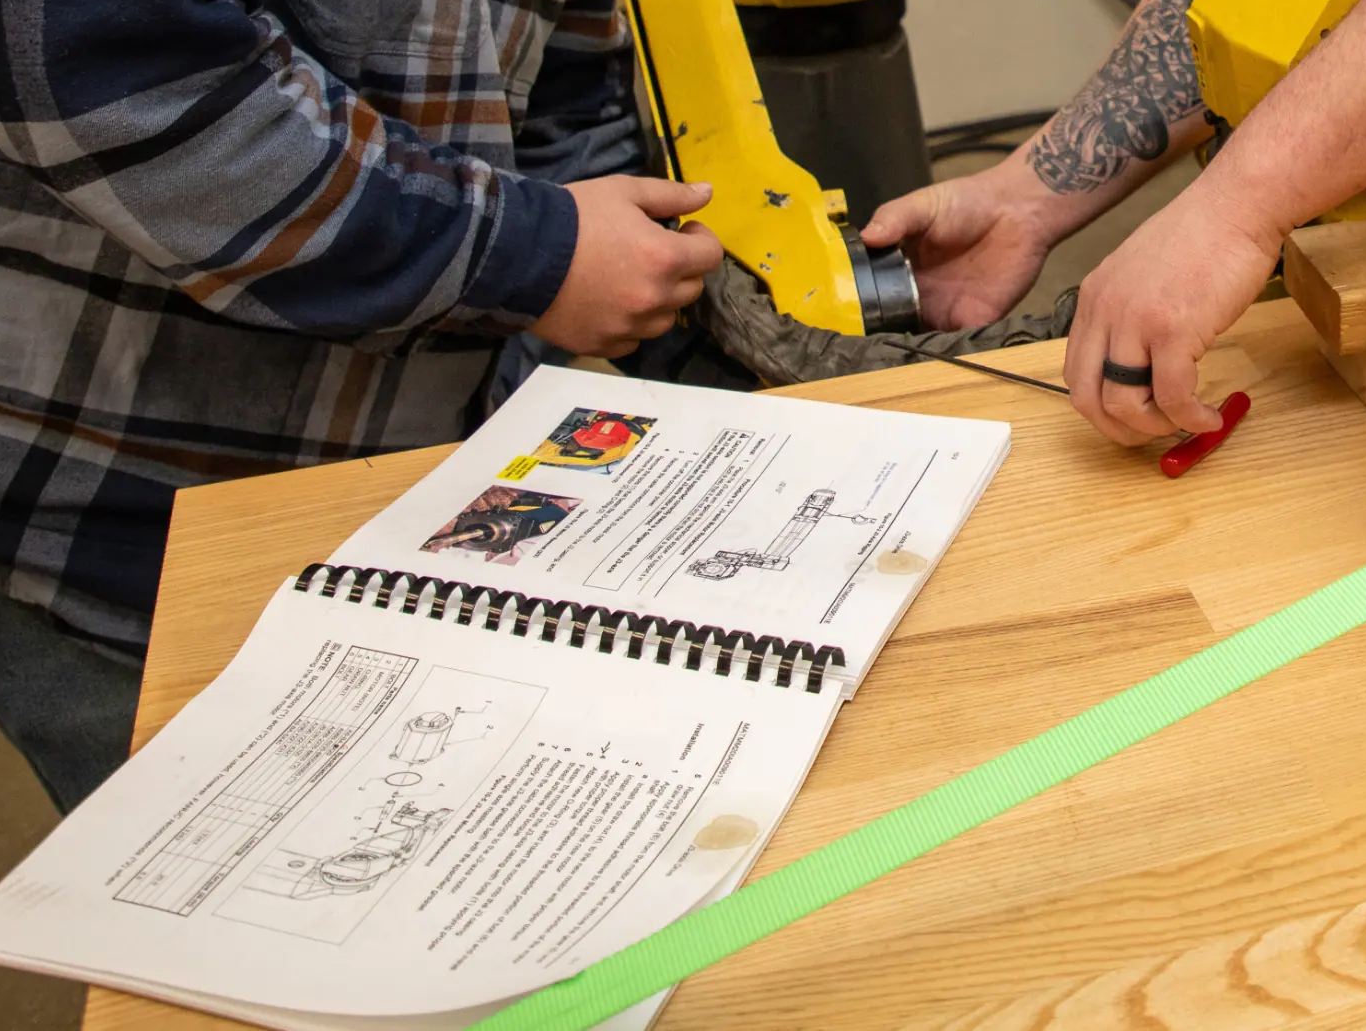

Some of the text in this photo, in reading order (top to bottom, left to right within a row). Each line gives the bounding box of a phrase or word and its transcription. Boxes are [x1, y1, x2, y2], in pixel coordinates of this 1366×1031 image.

[677, 722, 705, 761] Installation
[578, 765, 599, 785] Attach
[652, 780, 671, 798] Apply
[671, 785, 695, 810] Remove
[664, 810, 678, 820] the
